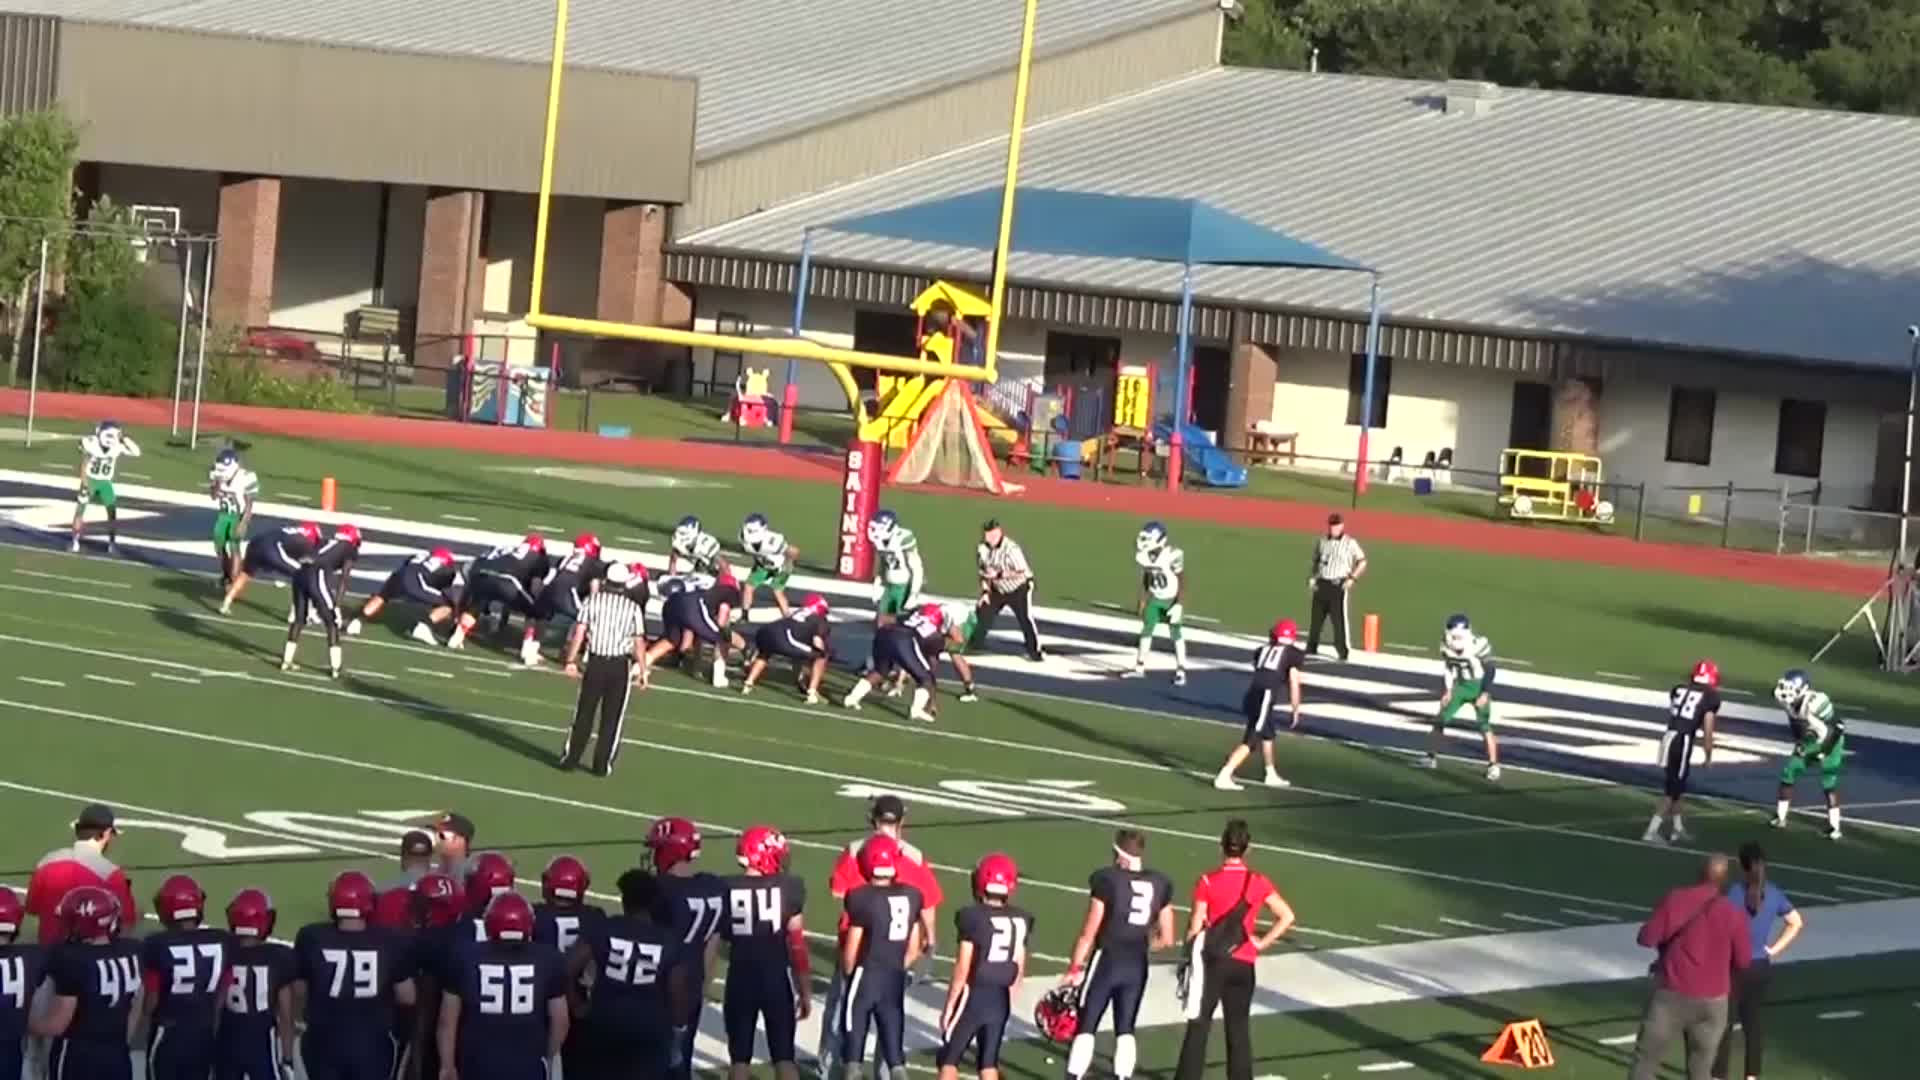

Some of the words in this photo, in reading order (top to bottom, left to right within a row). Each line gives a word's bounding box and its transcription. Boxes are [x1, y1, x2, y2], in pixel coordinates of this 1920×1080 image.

[1671, 687, 1704, 720] 28
[683, 896, 723, 943] 77
[730, 887, 782, 936] 94
[888, 896, 910, 941] 8
[1128, 880, 1154, 926] 3
[605, 936, 663, 985] 32
[988, 916, 1027, 963] 21
[96, 955, 141, 1008] 44
[168, 943, 223, 994] 27
[226, 965, 269, 1013] 81
[322, 949, 378, 998] 79
[478, 964, 535, 1014] 56
[1521, 1025, 1549, 1065] 20
